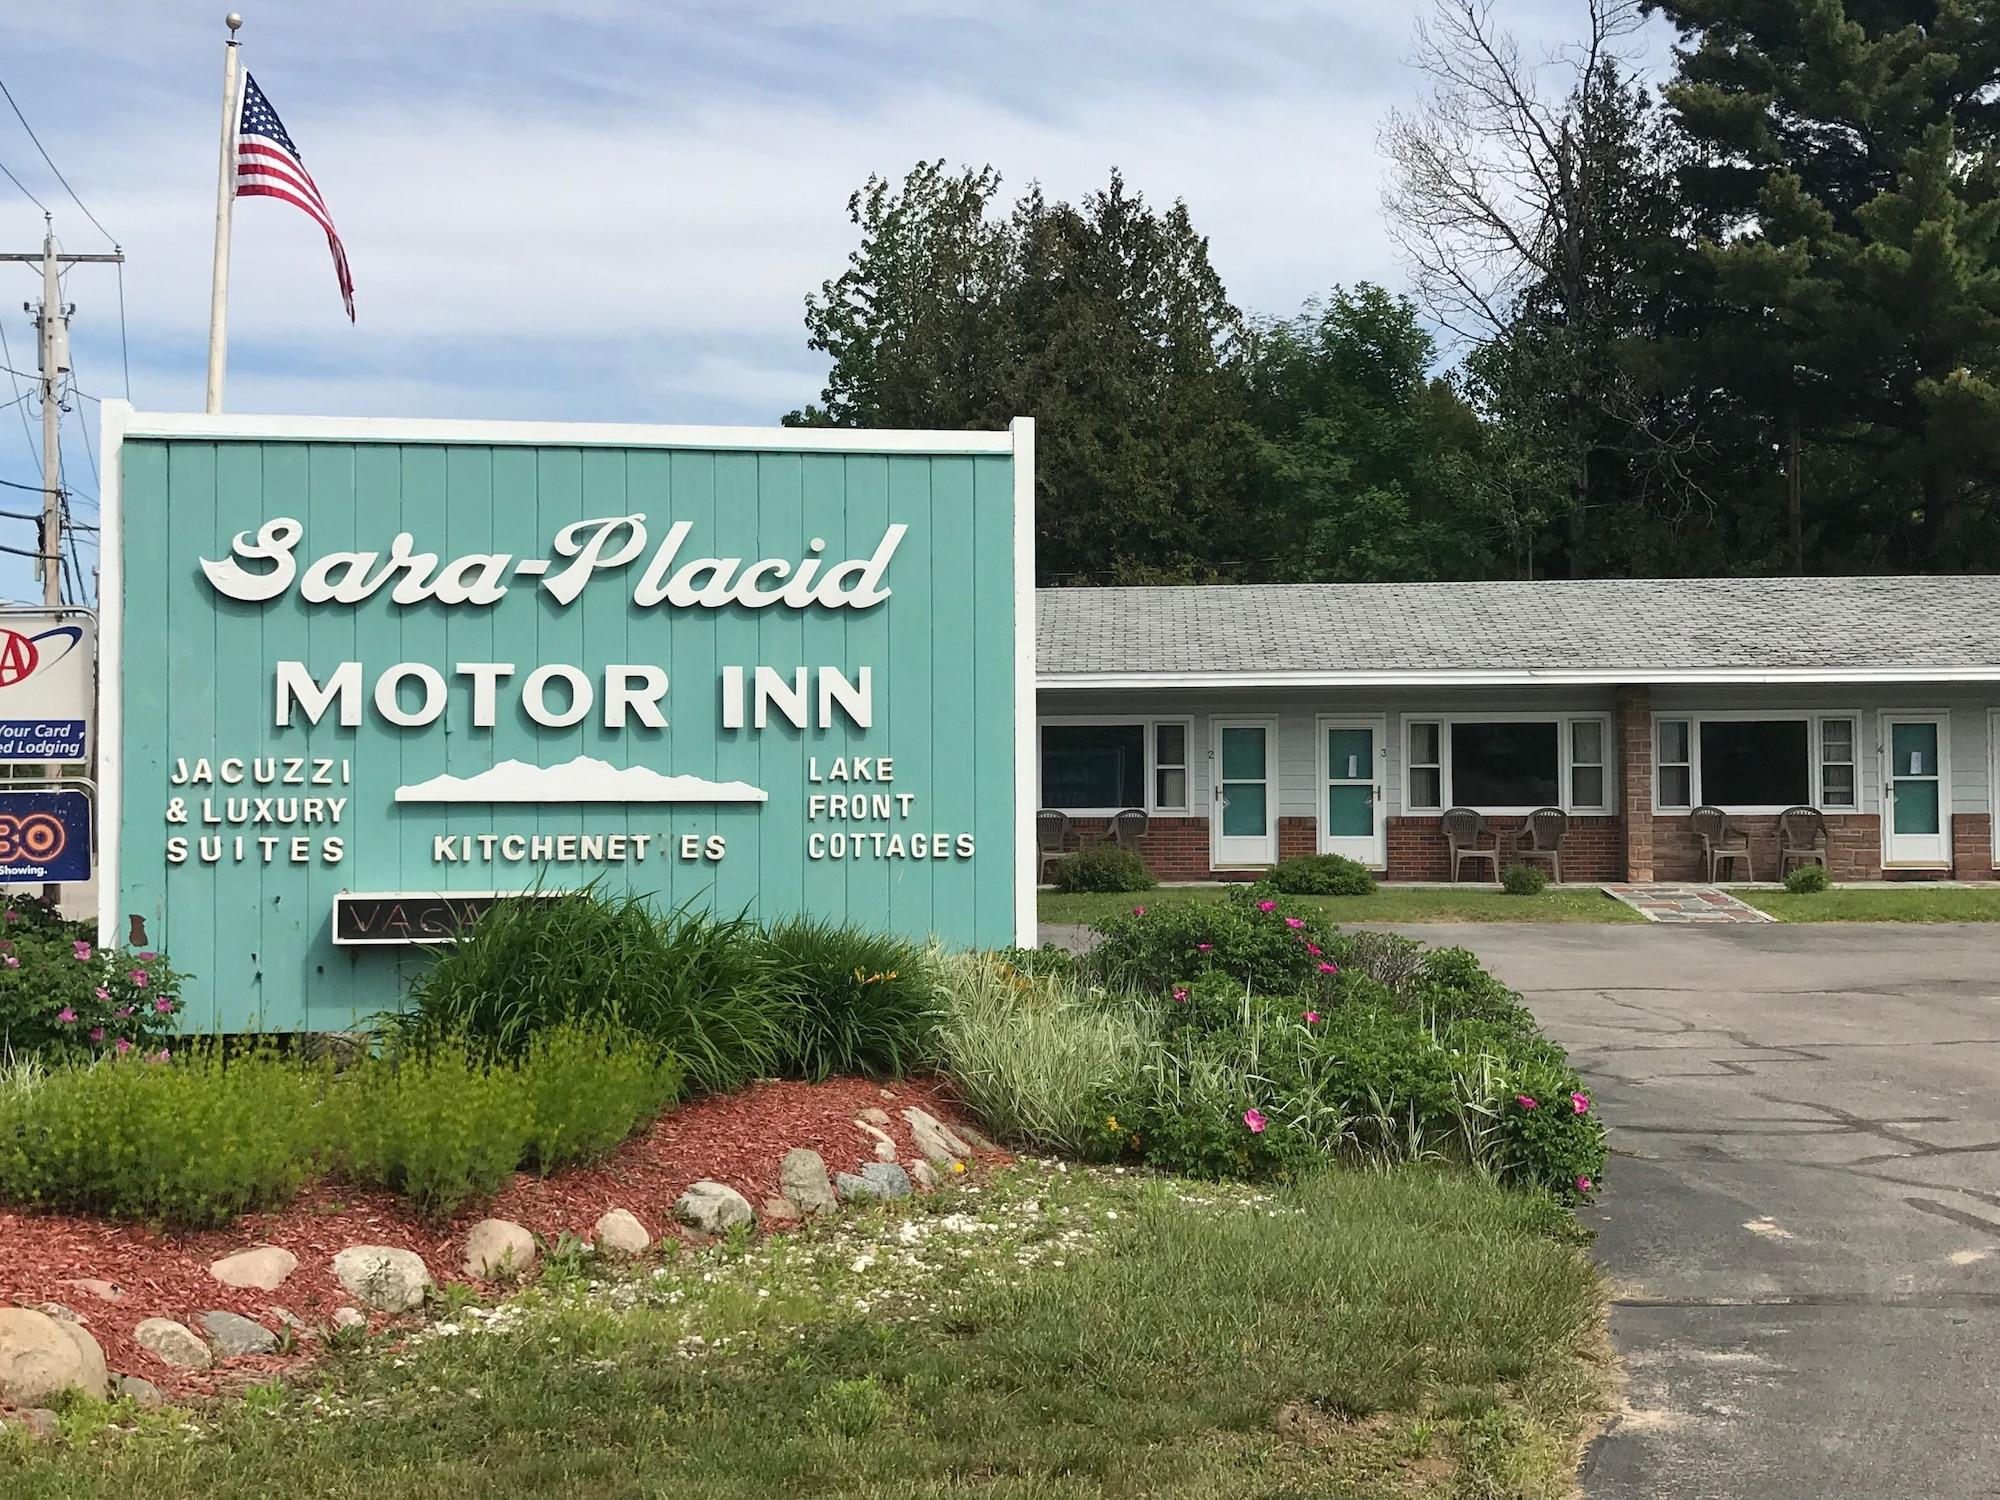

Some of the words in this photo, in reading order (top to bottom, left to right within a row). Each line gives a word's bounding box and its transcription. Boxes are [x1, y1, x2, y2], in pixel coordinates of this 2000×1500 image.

[199, 512, 909, 609] Sara-Placid
[276, 660, 670, 728] MOTOR
[723, 665, 873, 729] INN
[34, 724, 71, 737] Card
[17, 740, 80, 756] Lodging
[1207, 750, 1215, 760] 2
[1380, 748, 1387, 758] 3
[171, 757, 350, 785] JACUZZI
[809, 756, 894, 782] LAKE
[166, 797, 189, 823] &
[203, 797, 348, 823] LUXURY
[809, 793, 915, 819] FRONT
[166, 835, 344, 863] SUITES
[808, 832, 976, 859] COTTAGES
[0, 864, 48, 877] Showing.
